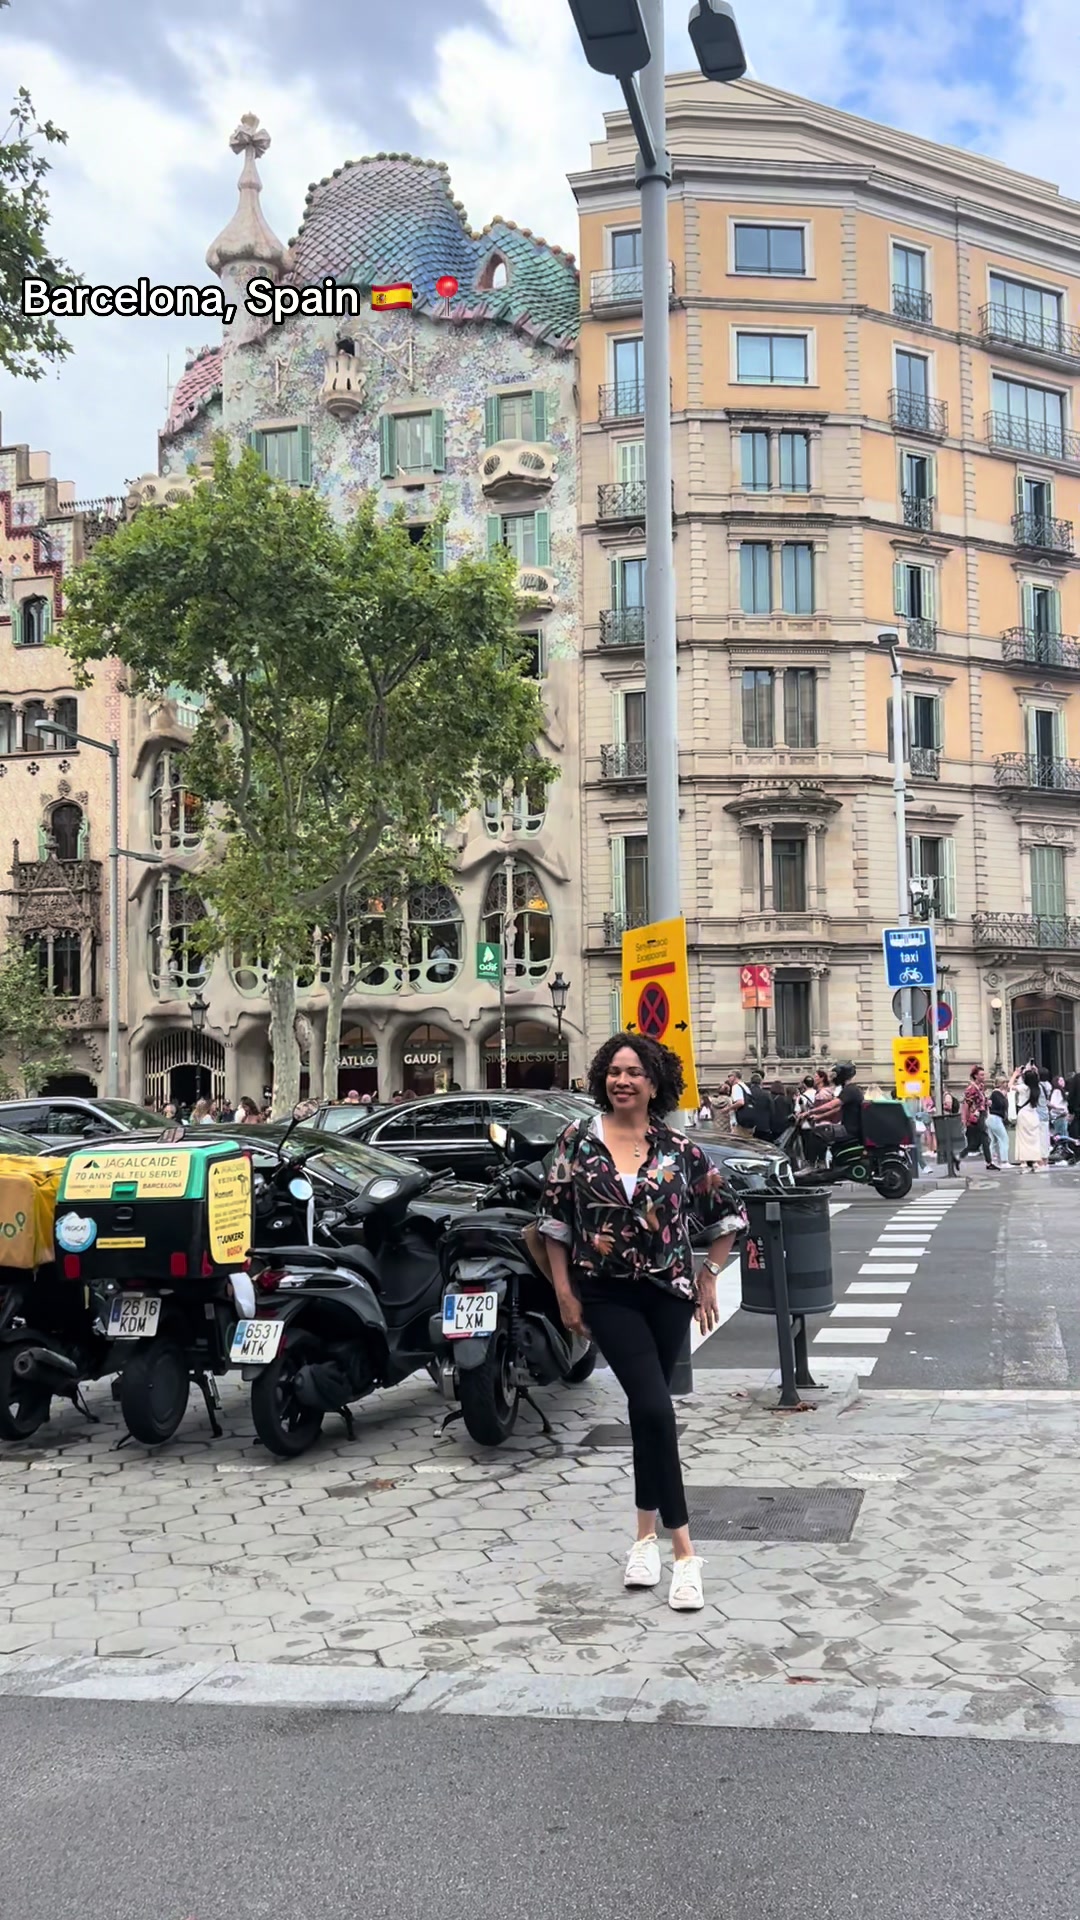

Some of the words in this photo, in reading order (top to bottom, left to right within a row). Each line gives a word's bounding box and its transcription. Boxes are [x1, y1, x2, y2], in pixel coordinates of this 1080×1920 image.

[900, 951, 919, 963] taxi
[479, 963, 498, 972] adif
[404, 1051, 441, 1065] GAUDÍ
[104, 1156, 178, 1169] JAGALCAIDE
[75, 1172, 87, 1180] 70
[88, 1172, 112, 1180] ANYS
[115, 1171, 126, 1179] AL
[129, 1170, 146, 1179] TEU
[222, 1231, 244, 1244] JUNKERS
[122, 1301, 158, 1316] 2616
[456, 1295, 494, 1312] 4720
[119, 1317, 145, 1332] KDM
[455, 1313, 483, 1329] LXM
[246, 1324, 279, 1339] 6531
[240, 1340, 268, 1355] MTK
